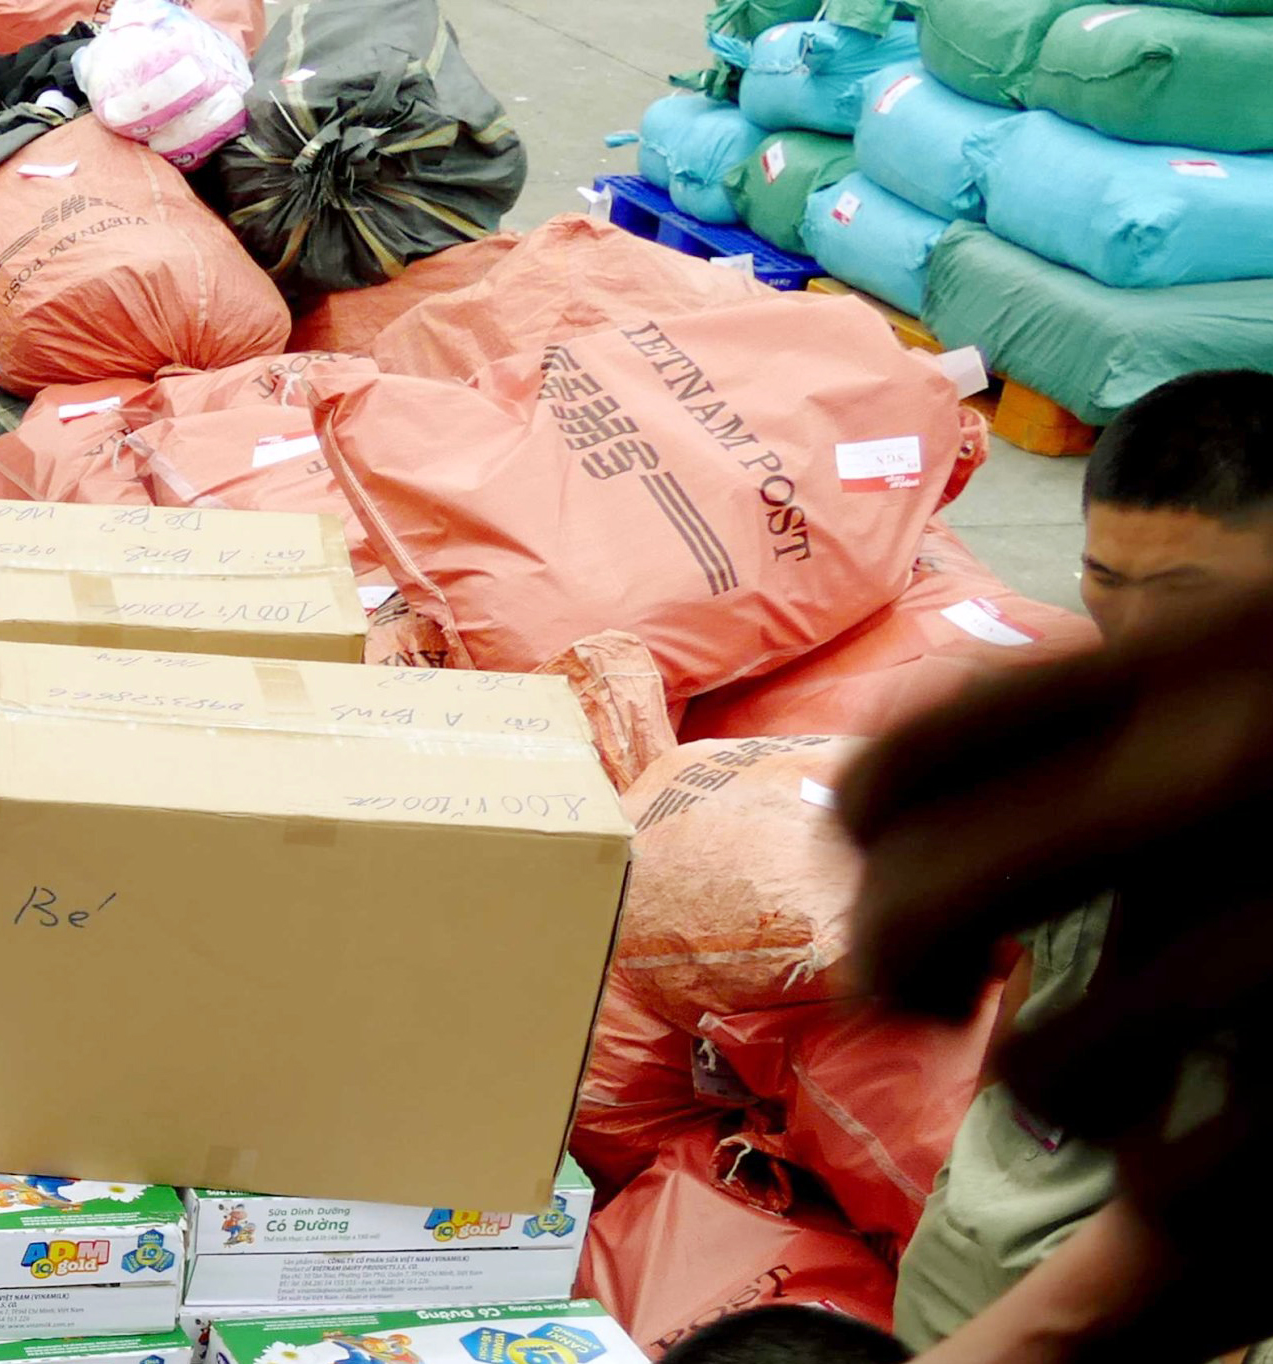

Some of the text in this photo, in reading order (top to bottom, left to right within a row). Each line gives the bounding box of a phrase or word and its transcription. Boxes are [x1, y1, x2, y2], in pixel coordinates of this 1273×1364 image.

[3, 216, 149, 307] VIETNAM POST
[621, 321, 811, 562] IETNAM POST
[268, 1207, 351, 1218] Sữa Dinh Dưỡng
[265, 1218, 349, 1233] Có Đường
[456, 1221, 503, 1240] gold
[55, 1259, 98, 1277] gold
[417, 1310, 474, 1320] Đường
